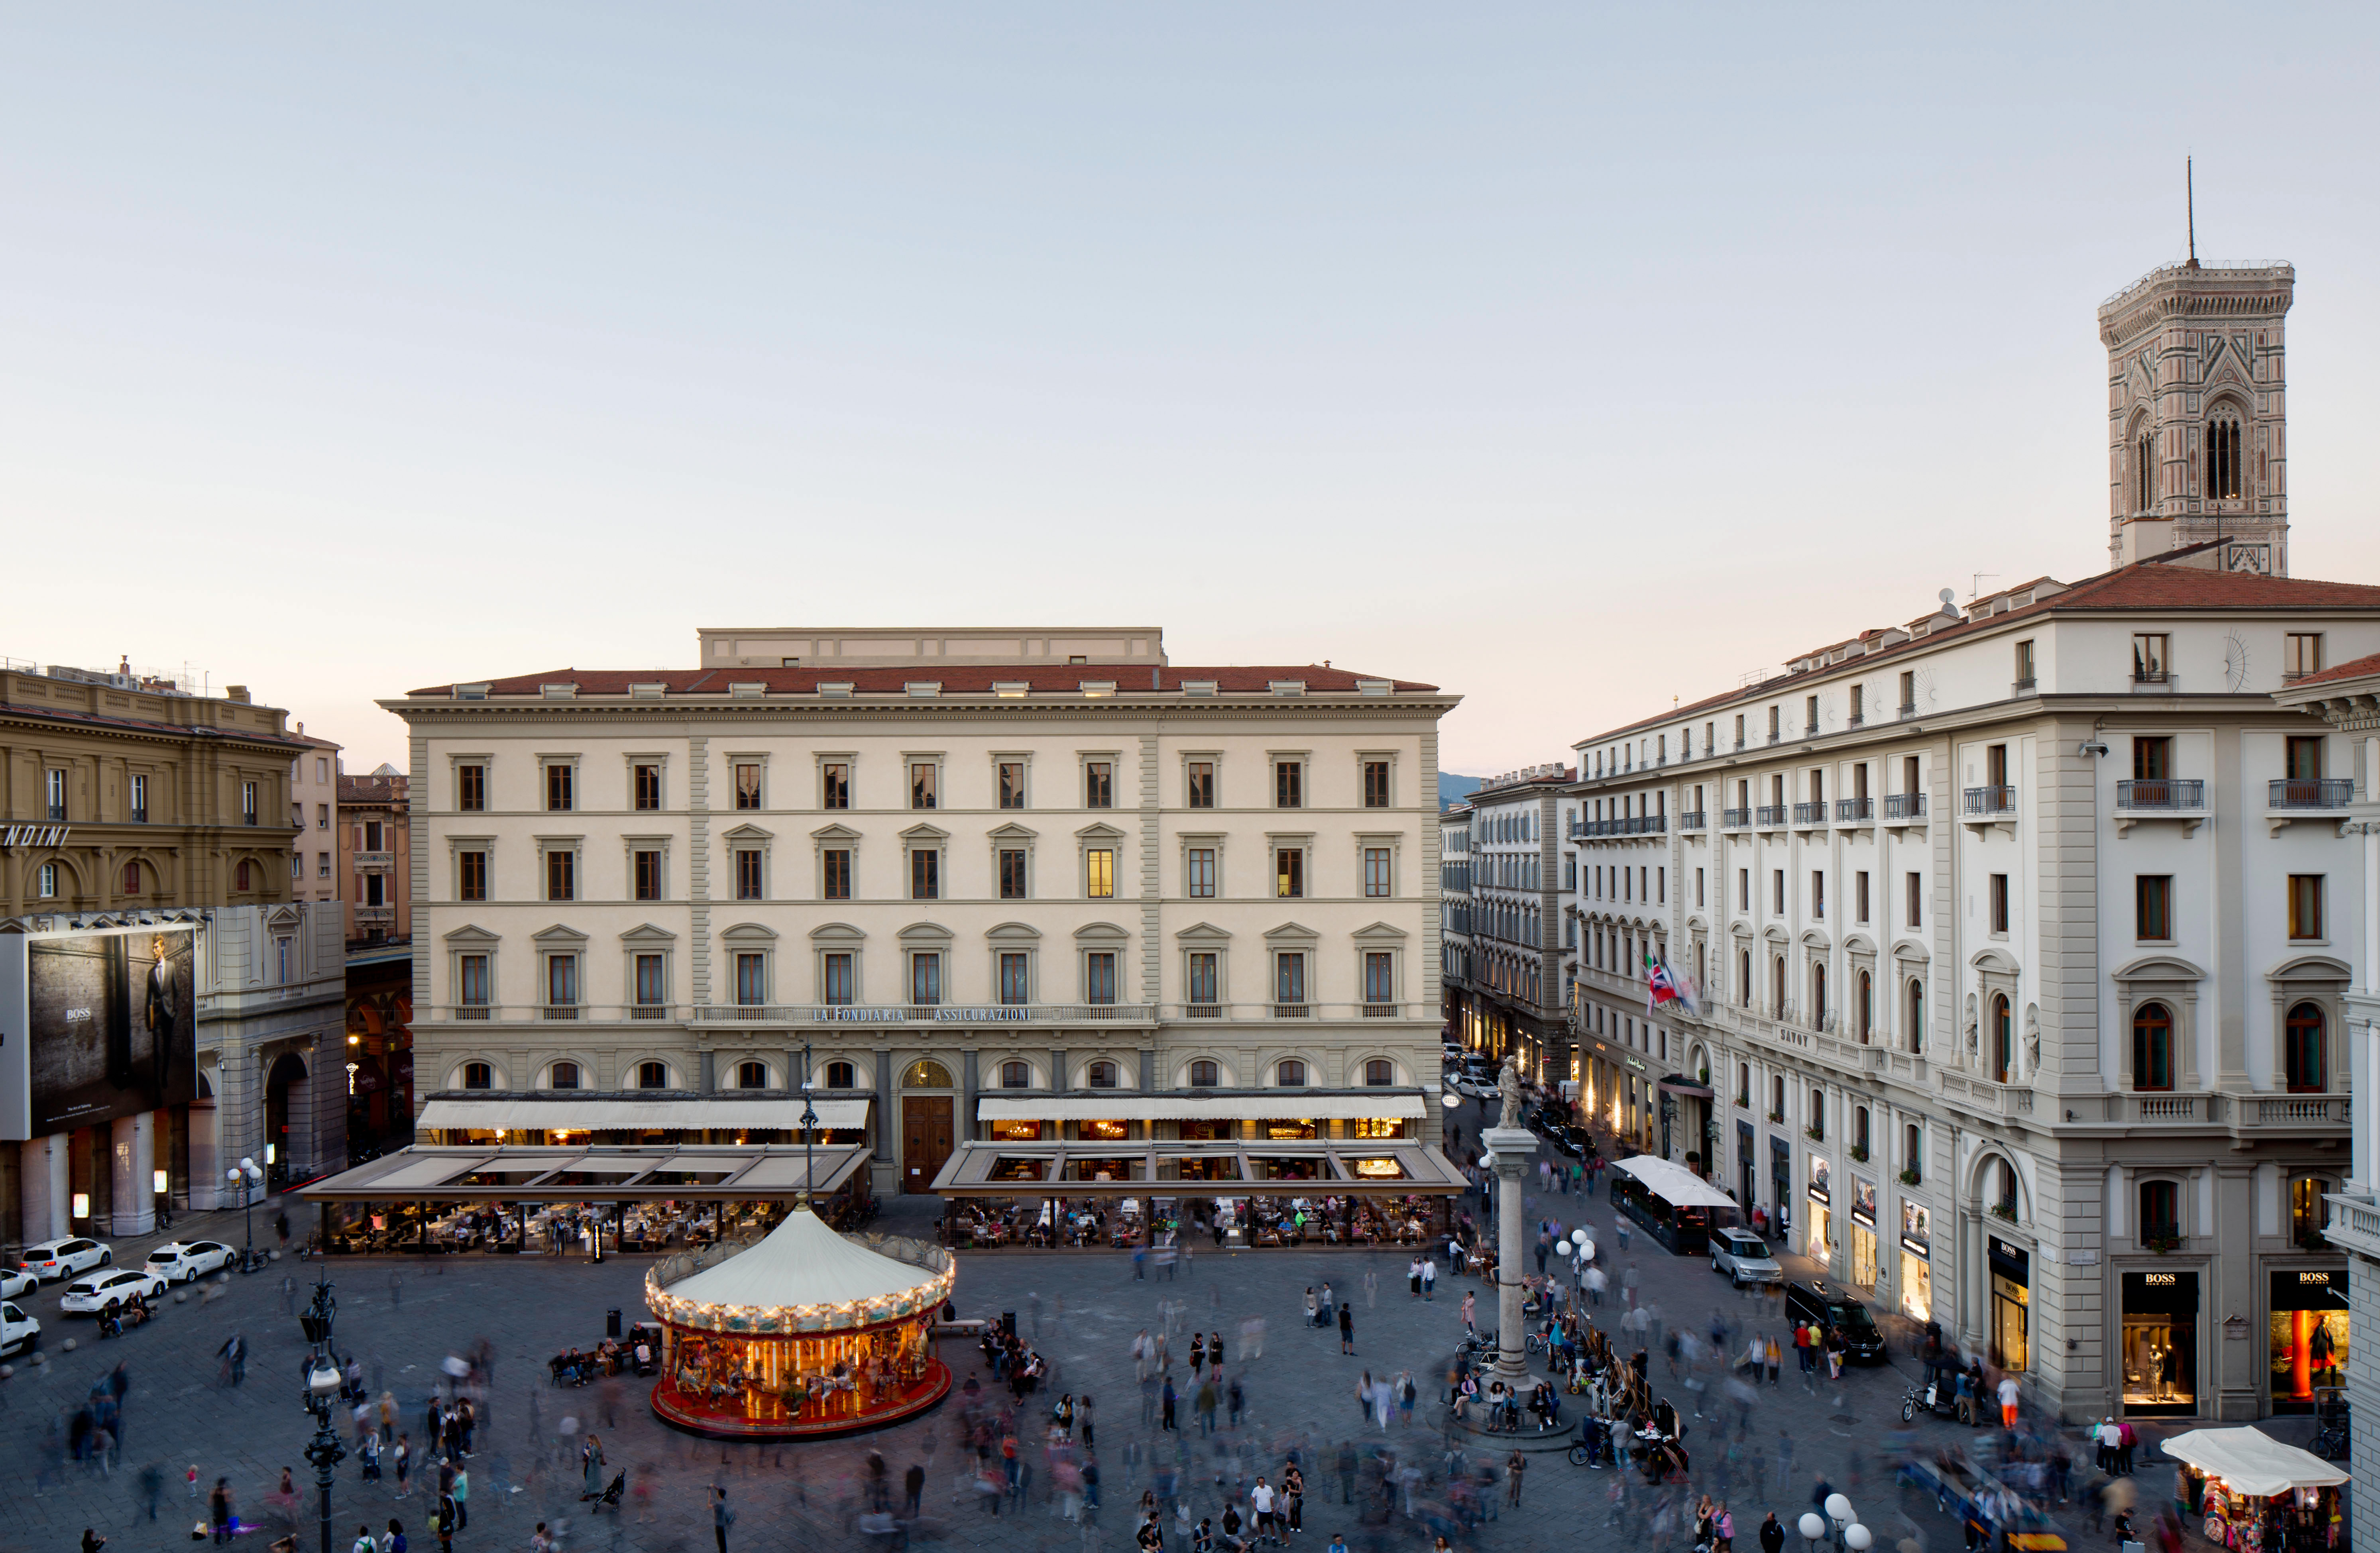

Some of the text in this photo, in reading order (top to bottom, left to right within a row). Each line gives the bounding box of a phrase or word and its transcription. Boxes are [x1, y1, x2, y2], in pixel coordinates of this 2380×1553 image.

[0, 825, 71, 846] NDINI
[67, 1007, 91, 1019] BOSS
[814, 1007, 1030, 1021] LA FONDIARIA ASSICURAZIONI
[1781, 1029, 1808, 1047] SAVOY
[2001, 1242, 2016, 1256] BOSS
[2146, 1274, 2176, 1282] BOSS
[2299, 1272, 2329, 1281] BOSS
[2006, 1282, 2020, 1296] BOSS
